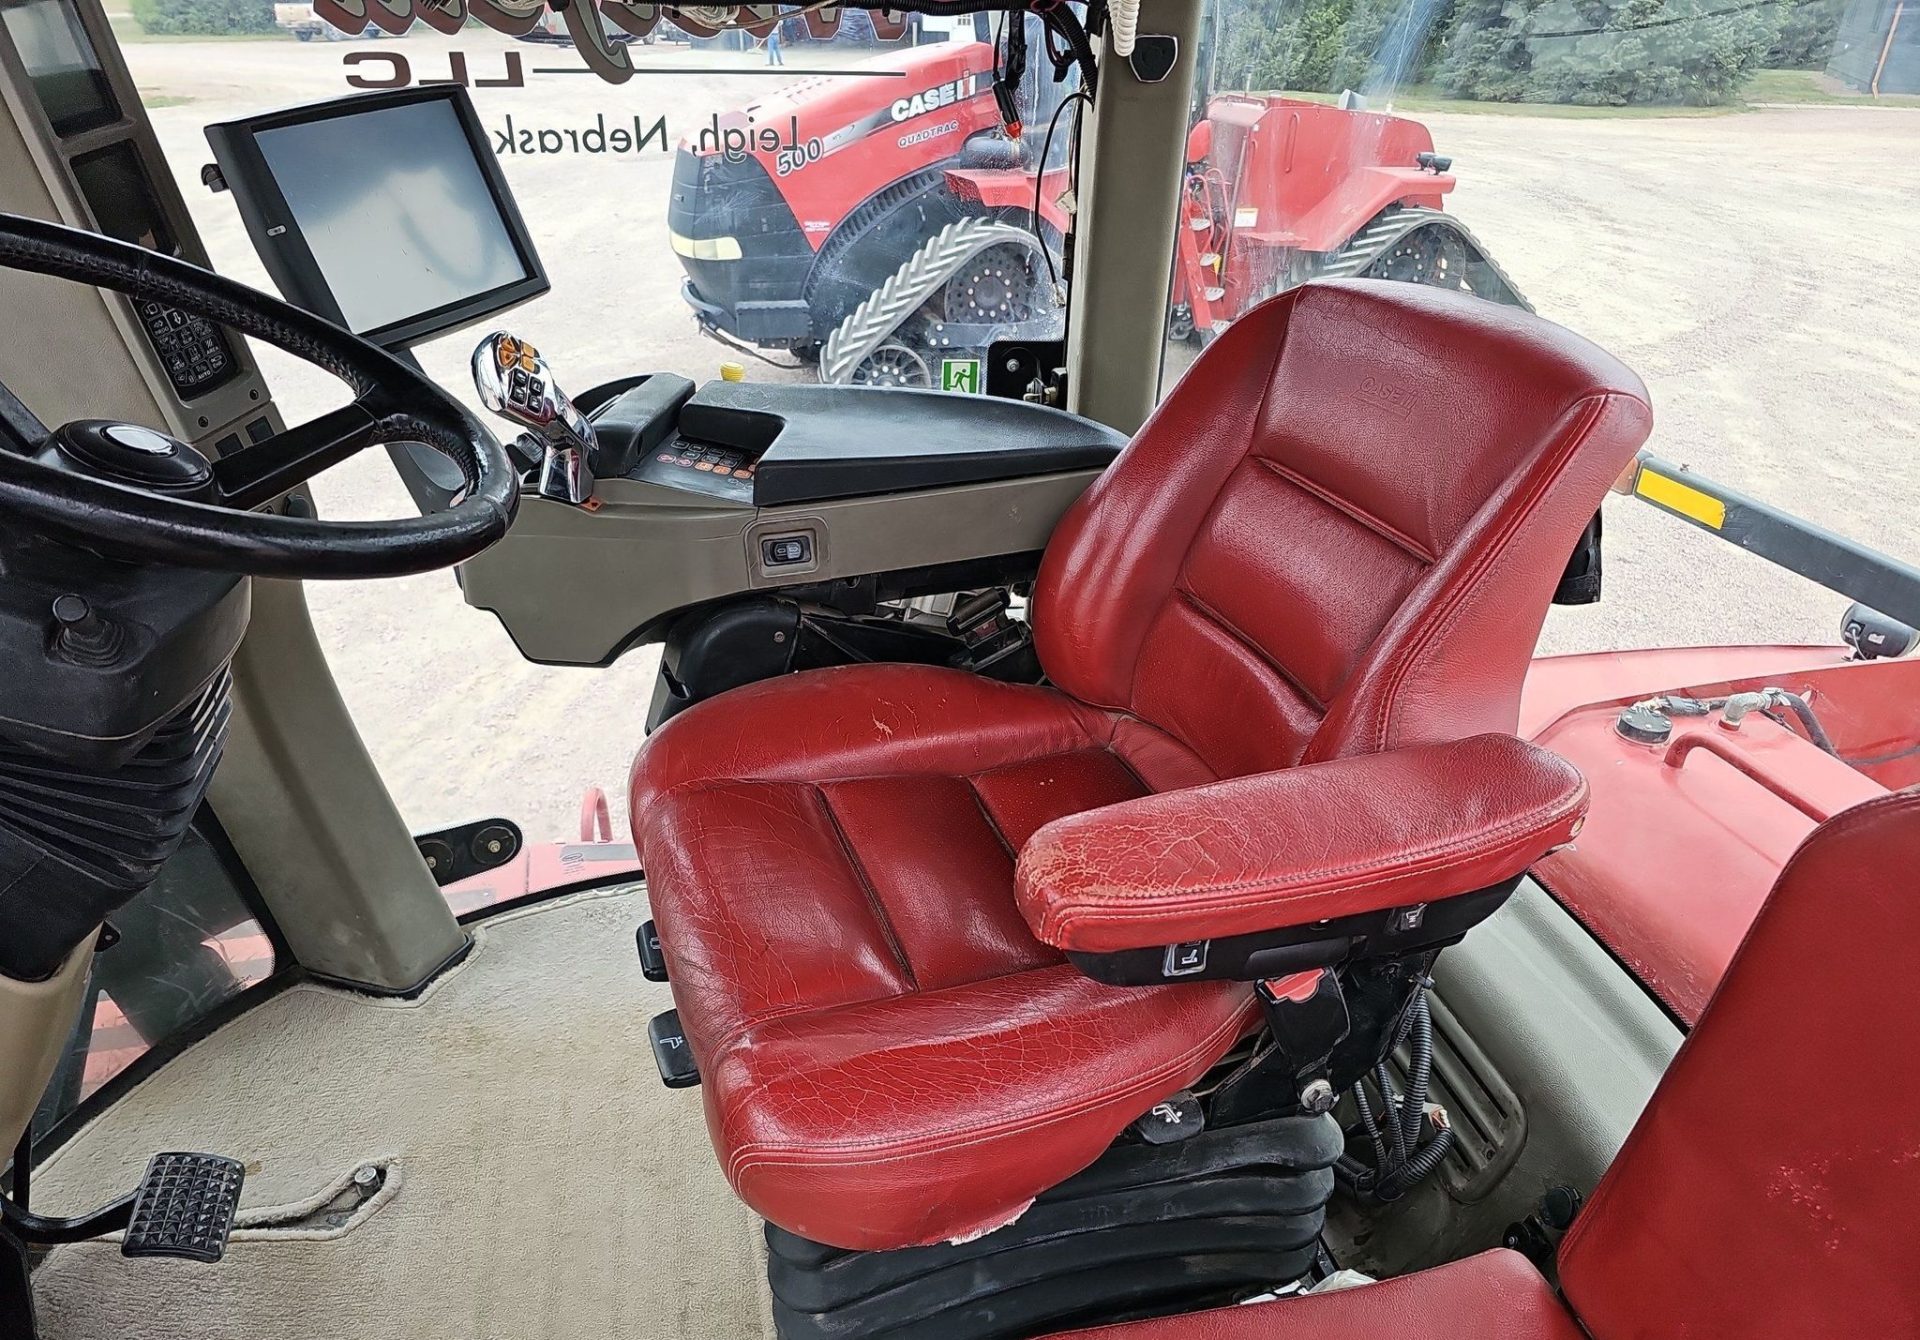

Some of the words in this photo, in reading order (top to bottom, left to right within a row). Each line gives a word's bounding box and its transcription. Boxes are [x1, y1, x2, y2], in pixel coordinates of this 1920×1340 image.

[898, 121, 960, 148] QUADTRAC
[776, 137, 823, 176] 500
[197, 370, 211, 380] AUTO
